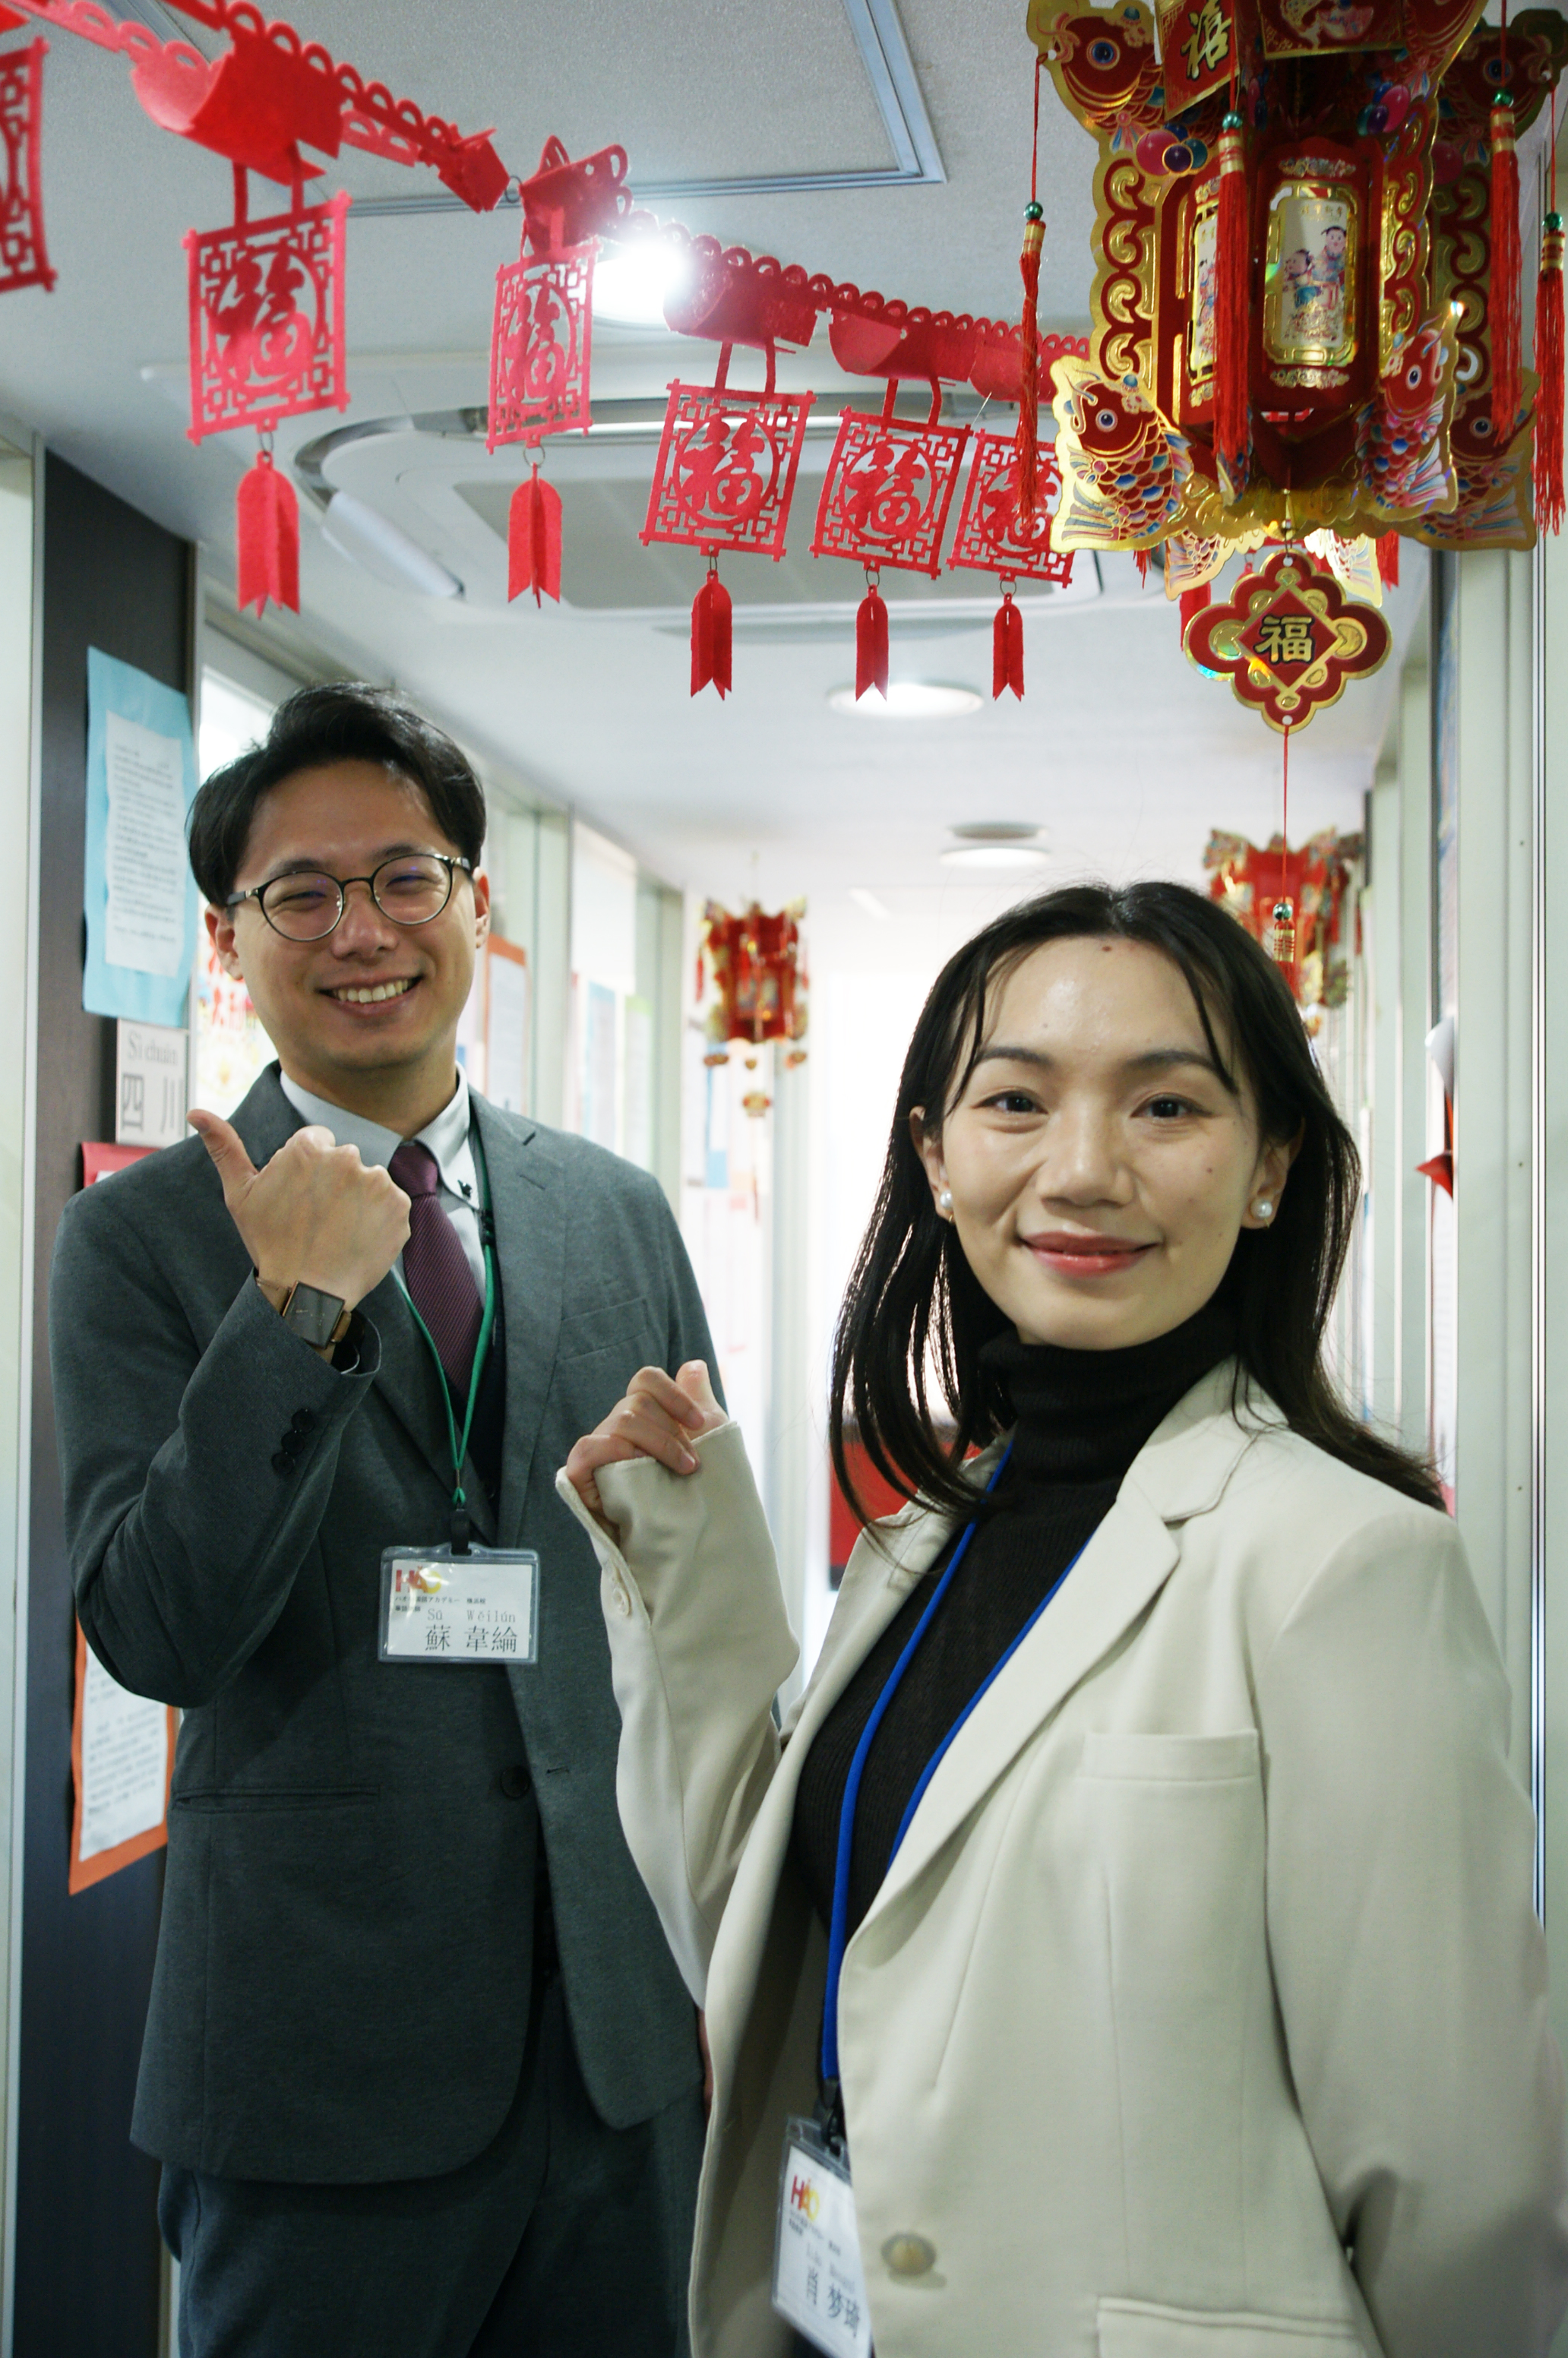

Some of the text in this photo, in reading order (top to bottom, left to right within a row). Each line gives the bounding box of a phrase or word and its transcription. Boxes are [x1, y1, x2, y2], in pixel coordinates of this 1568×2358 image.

[678, 414, 765, 524] 福
[844, 440, 922, 537] 福
[1253, 614, 1314, 664] 福
[122, 1073, 184, 1137] 四川
[425, 1624, 451, 1652] 蘇
